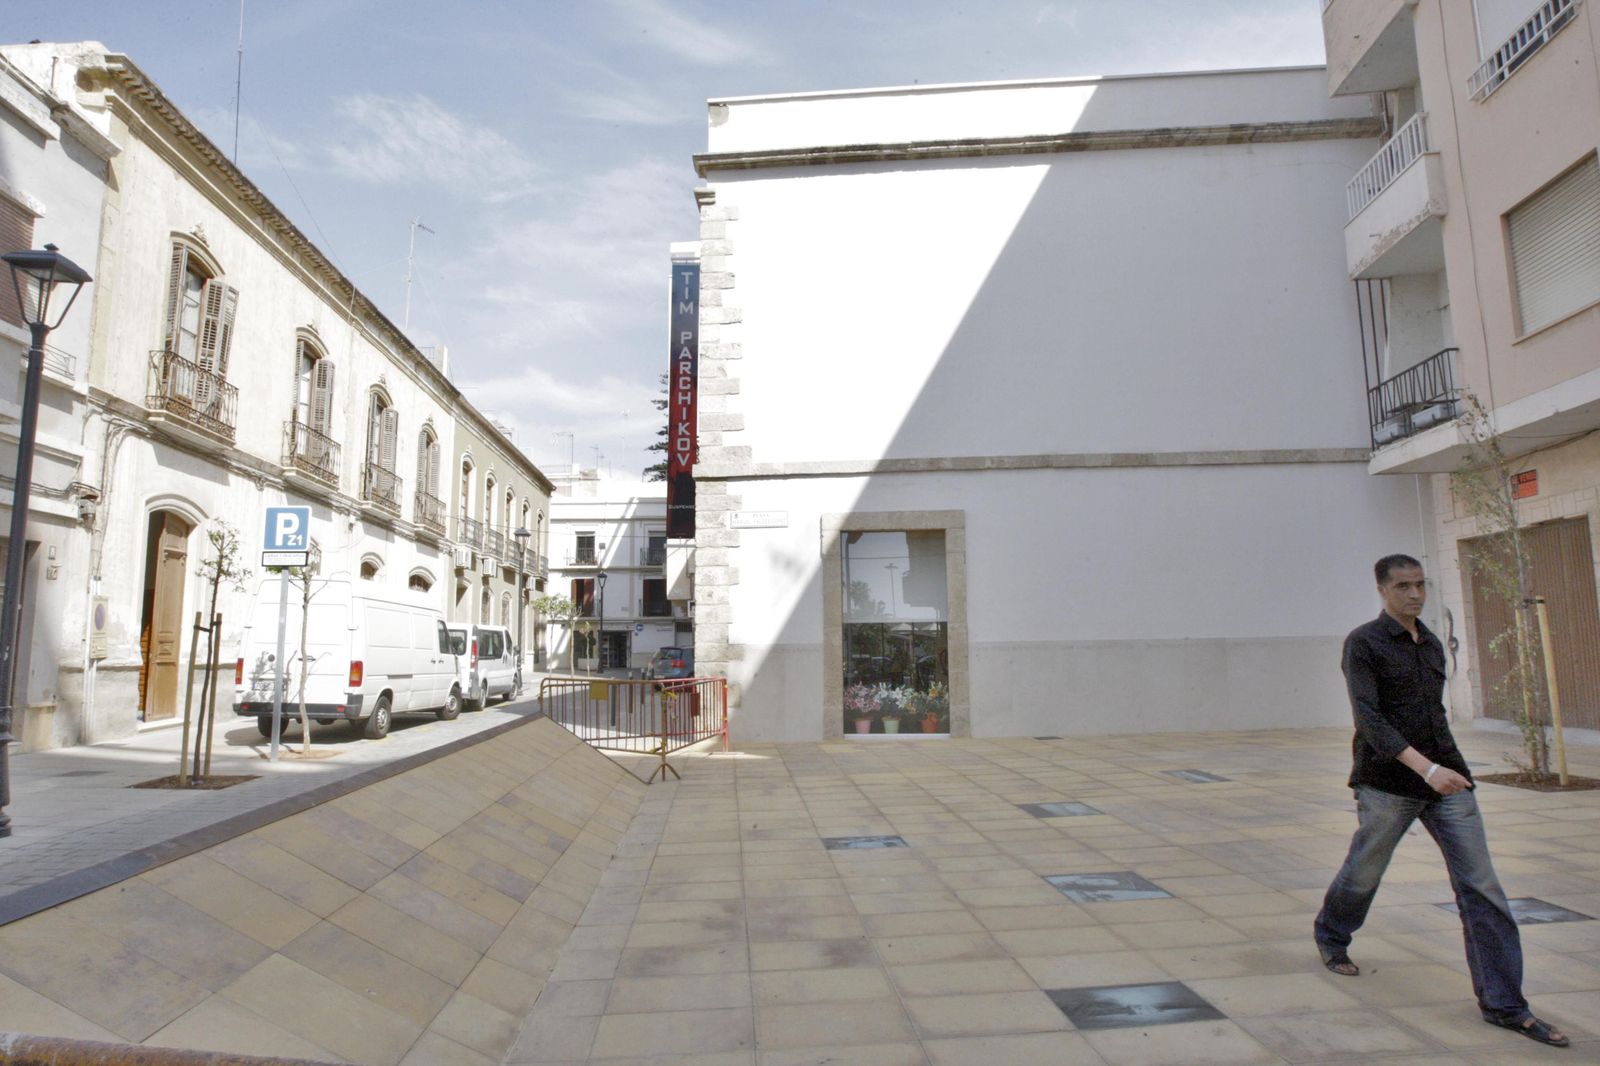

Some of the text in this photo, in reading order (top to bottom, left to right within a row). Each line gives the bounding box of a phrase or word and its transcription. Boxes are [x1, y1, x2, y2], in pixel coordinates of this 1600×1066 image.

[677, 271, 694, 466] TIM PARCHIKOV
[275, 512, 300, 546] P
[287, 534, 303, 546] Z1
